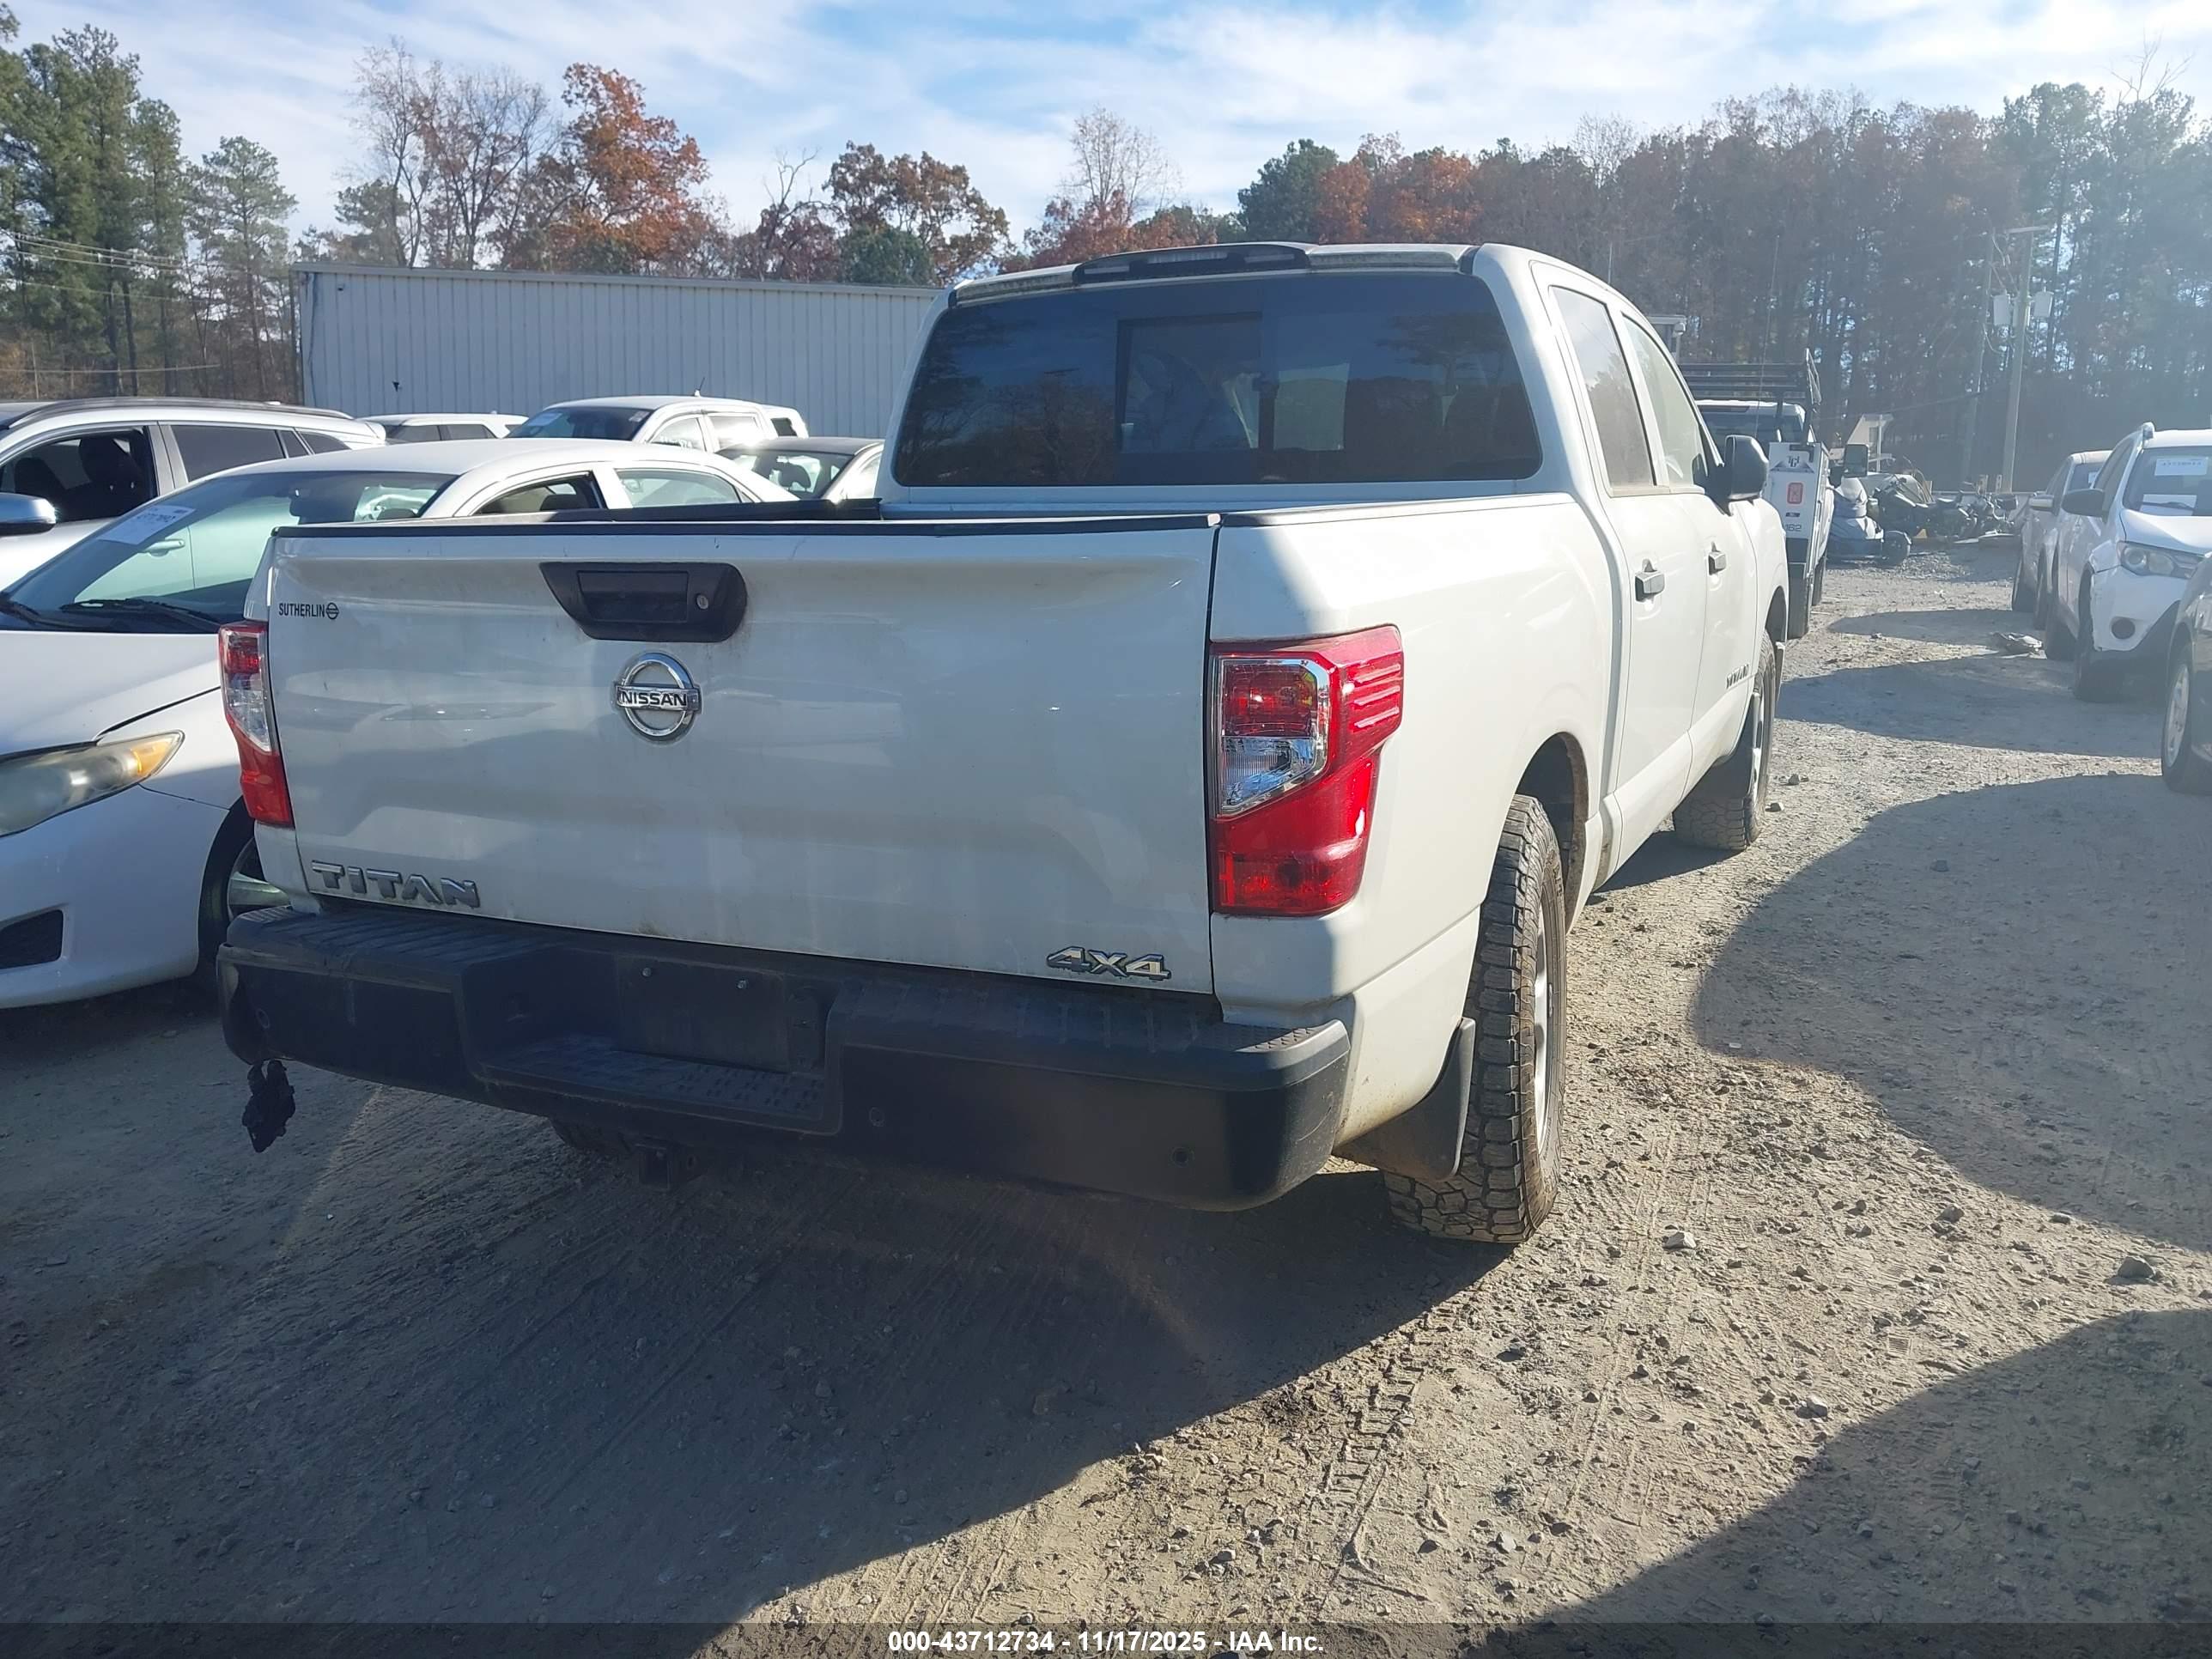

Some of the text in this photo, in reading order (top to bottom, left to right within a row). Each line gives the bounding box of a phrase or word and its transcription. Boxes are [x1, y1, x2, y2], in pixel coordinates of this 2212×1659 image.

[278, 603, 325, 617] SUTHERLIN
[621, 690, 687, 707] NISSAN
[312, 860, 481, 908] TITAN
